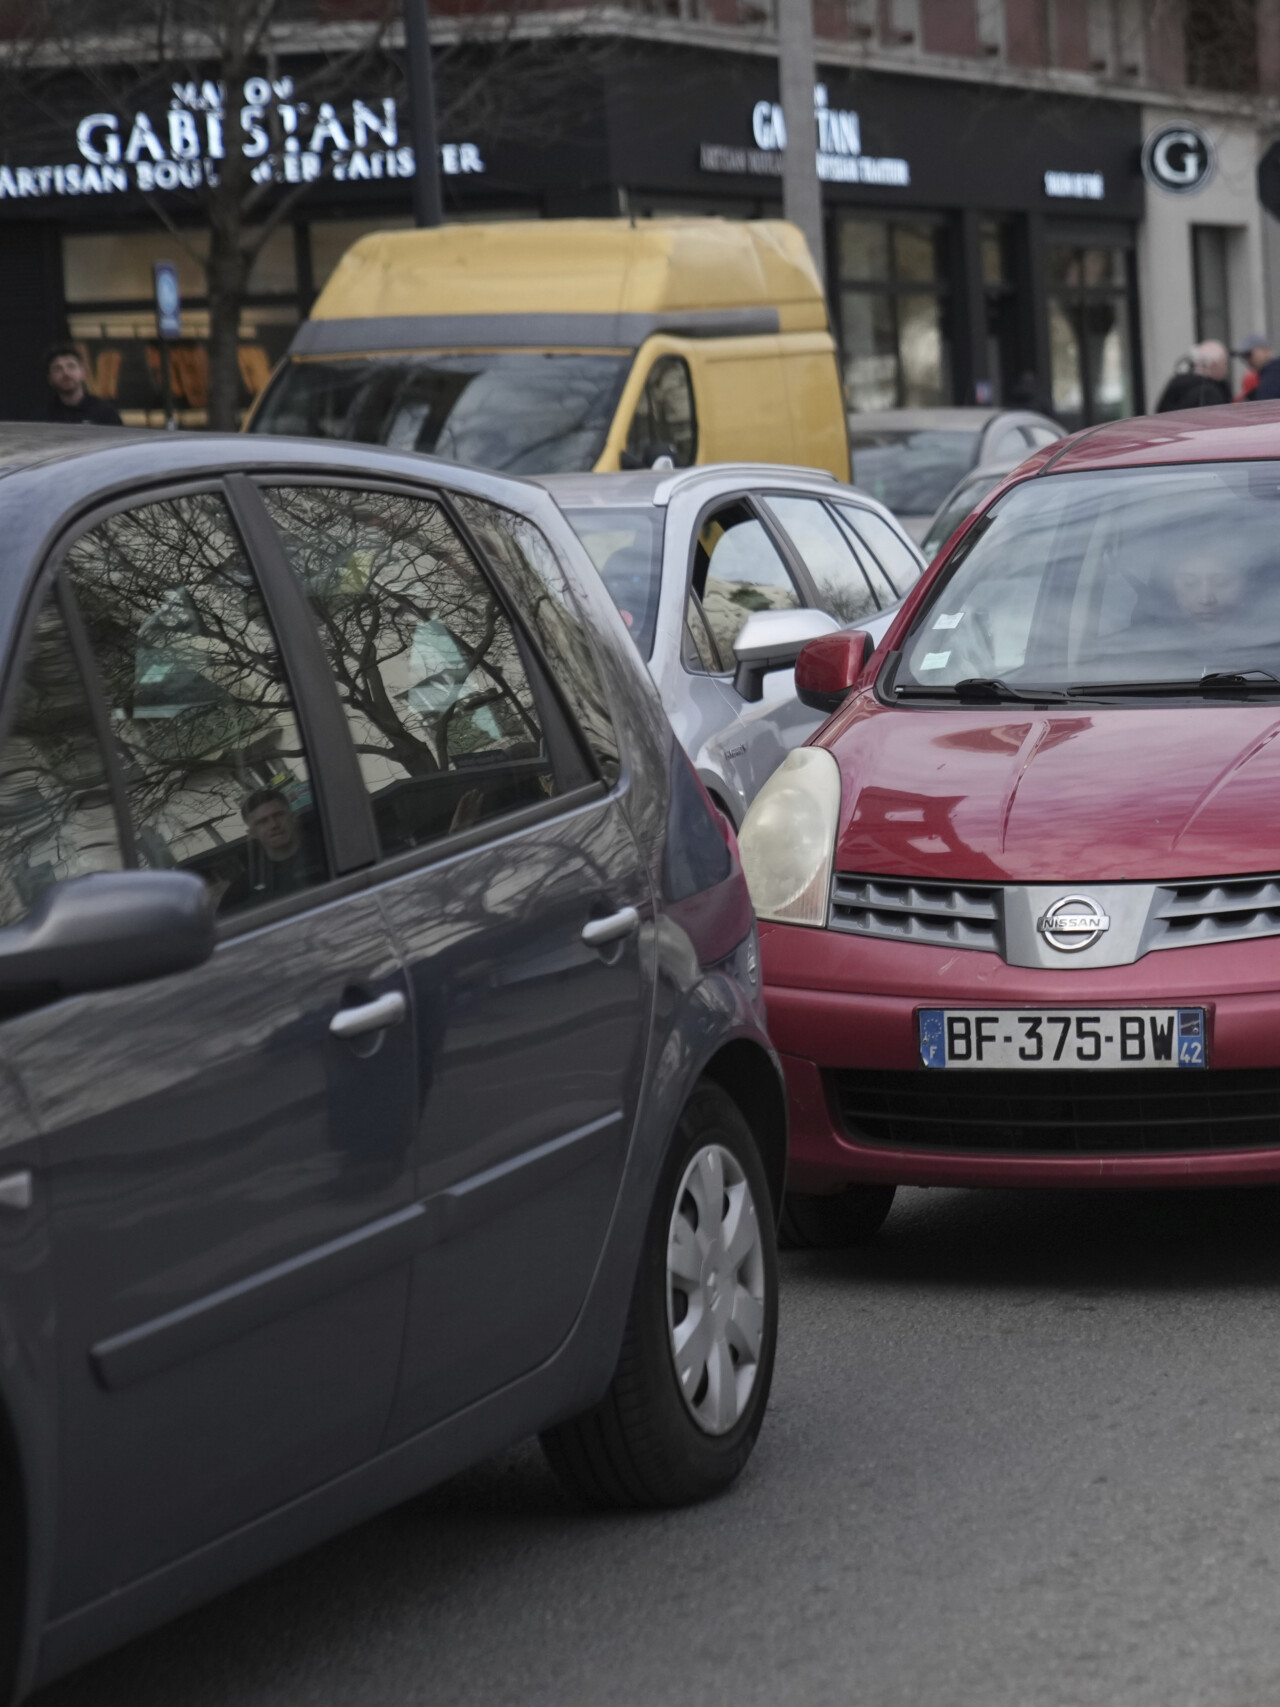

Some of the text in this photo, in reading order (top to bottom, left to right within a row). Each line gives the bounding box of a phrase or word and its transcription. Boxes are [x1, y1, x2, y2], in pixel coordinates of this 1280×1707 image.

[1153, 132, 1199, 184] G
[1043, 918, 1101, 929] NISSAN
[929, 1015, 1203, 1064] F BF-375-BW 42
